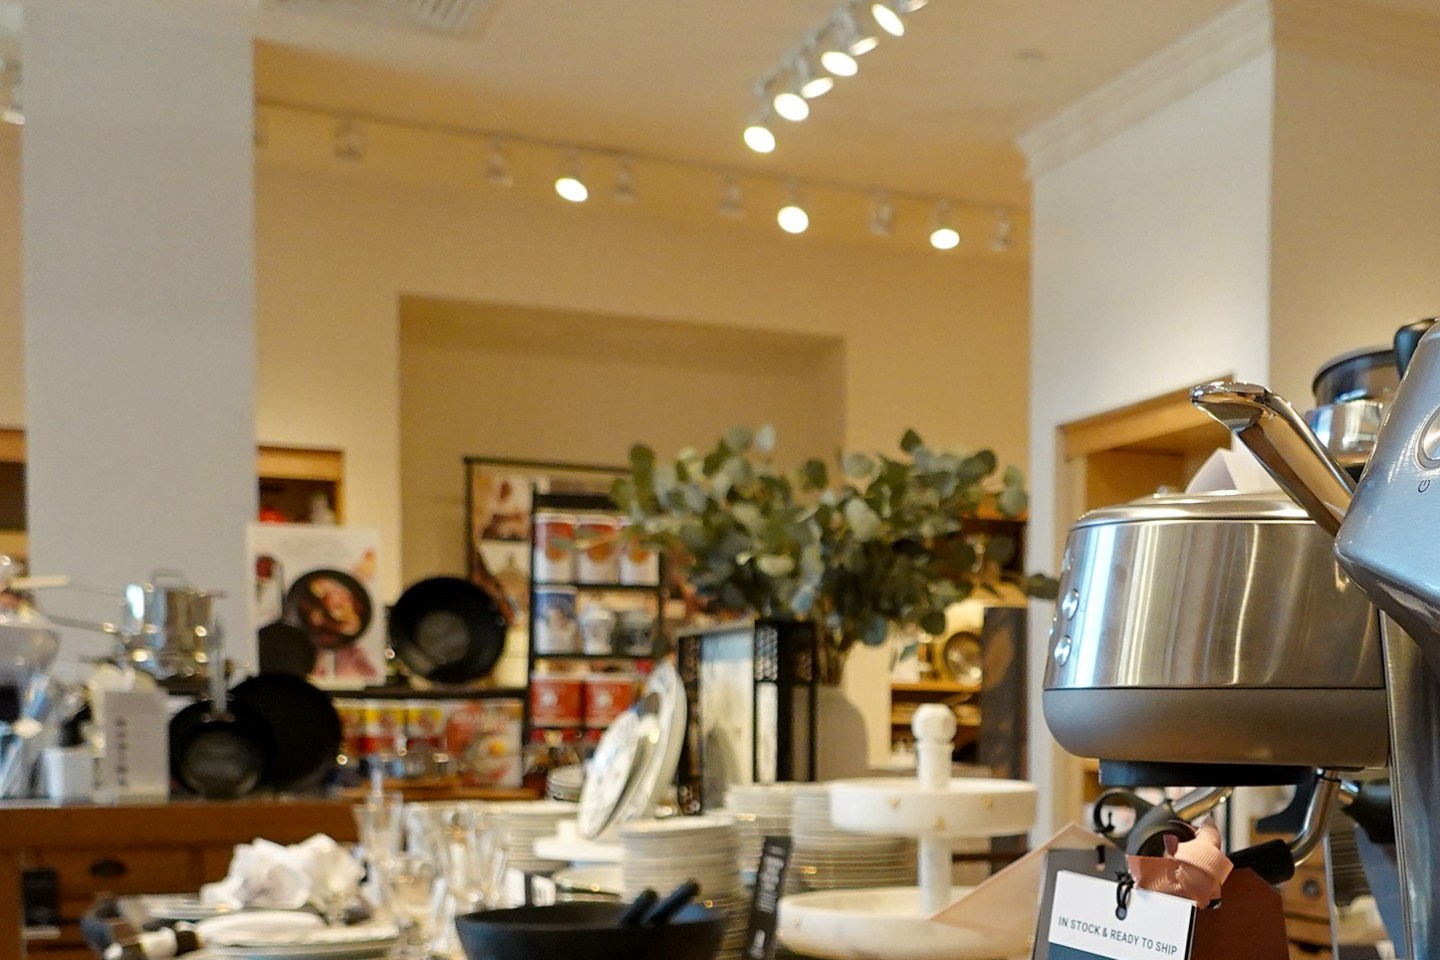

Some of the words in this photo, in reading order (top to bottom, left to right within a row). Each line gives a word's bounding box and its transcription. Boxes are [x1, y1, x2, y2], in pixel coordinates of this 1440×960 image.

[1058, 916, 1068, 927] IN
[1070, 920, 1101, 936] STOCK
[1102, 928, 1108, 937] &
[1110, 929, 1140, 945] READY
[1142, 937, 1153, 949] TO
[1155, 941, 1178, 956] SHIP
